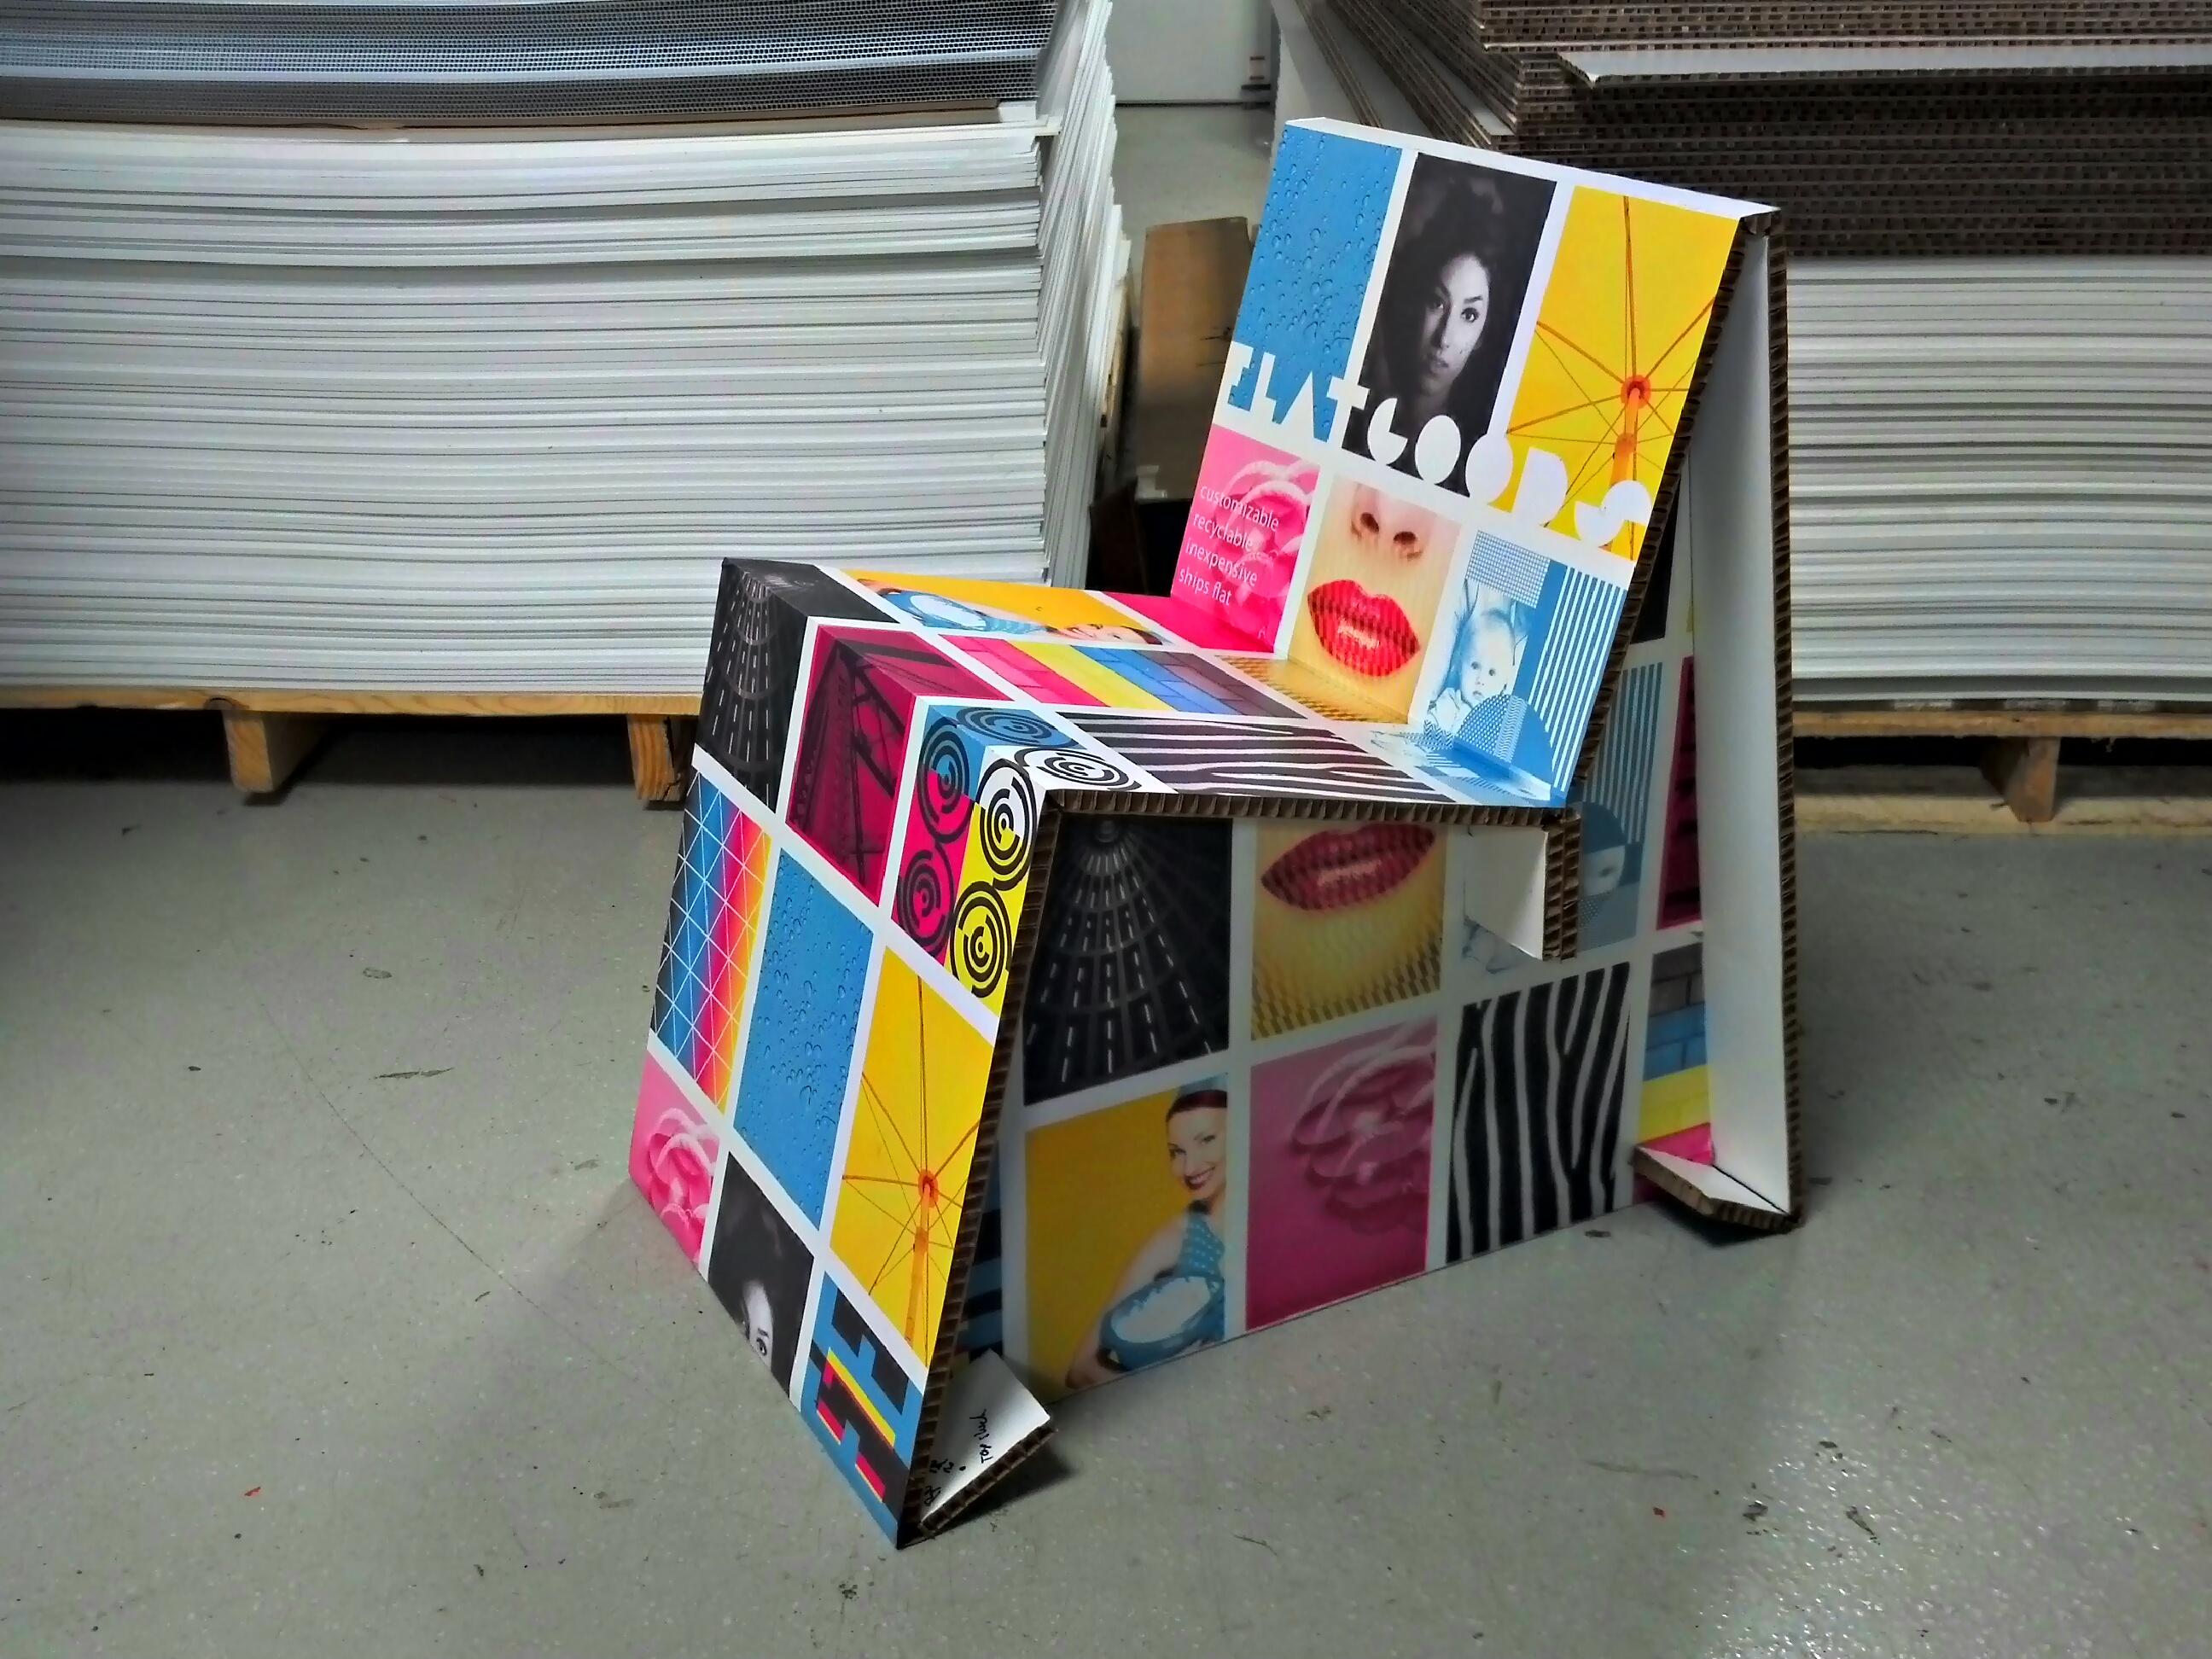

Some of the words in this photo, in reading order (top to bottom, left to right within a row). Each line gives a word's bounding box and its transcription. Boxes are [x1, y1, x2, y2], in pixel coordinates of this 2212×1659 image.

[1200, 486, 1279, 532] customizable
[1192, 513, 1253, 552] recyclable
[1185, 538, 1258, 587] inexpensive
[1178, 566, 1210, 594] ships
[1212, 581, 1232, 606] flat
